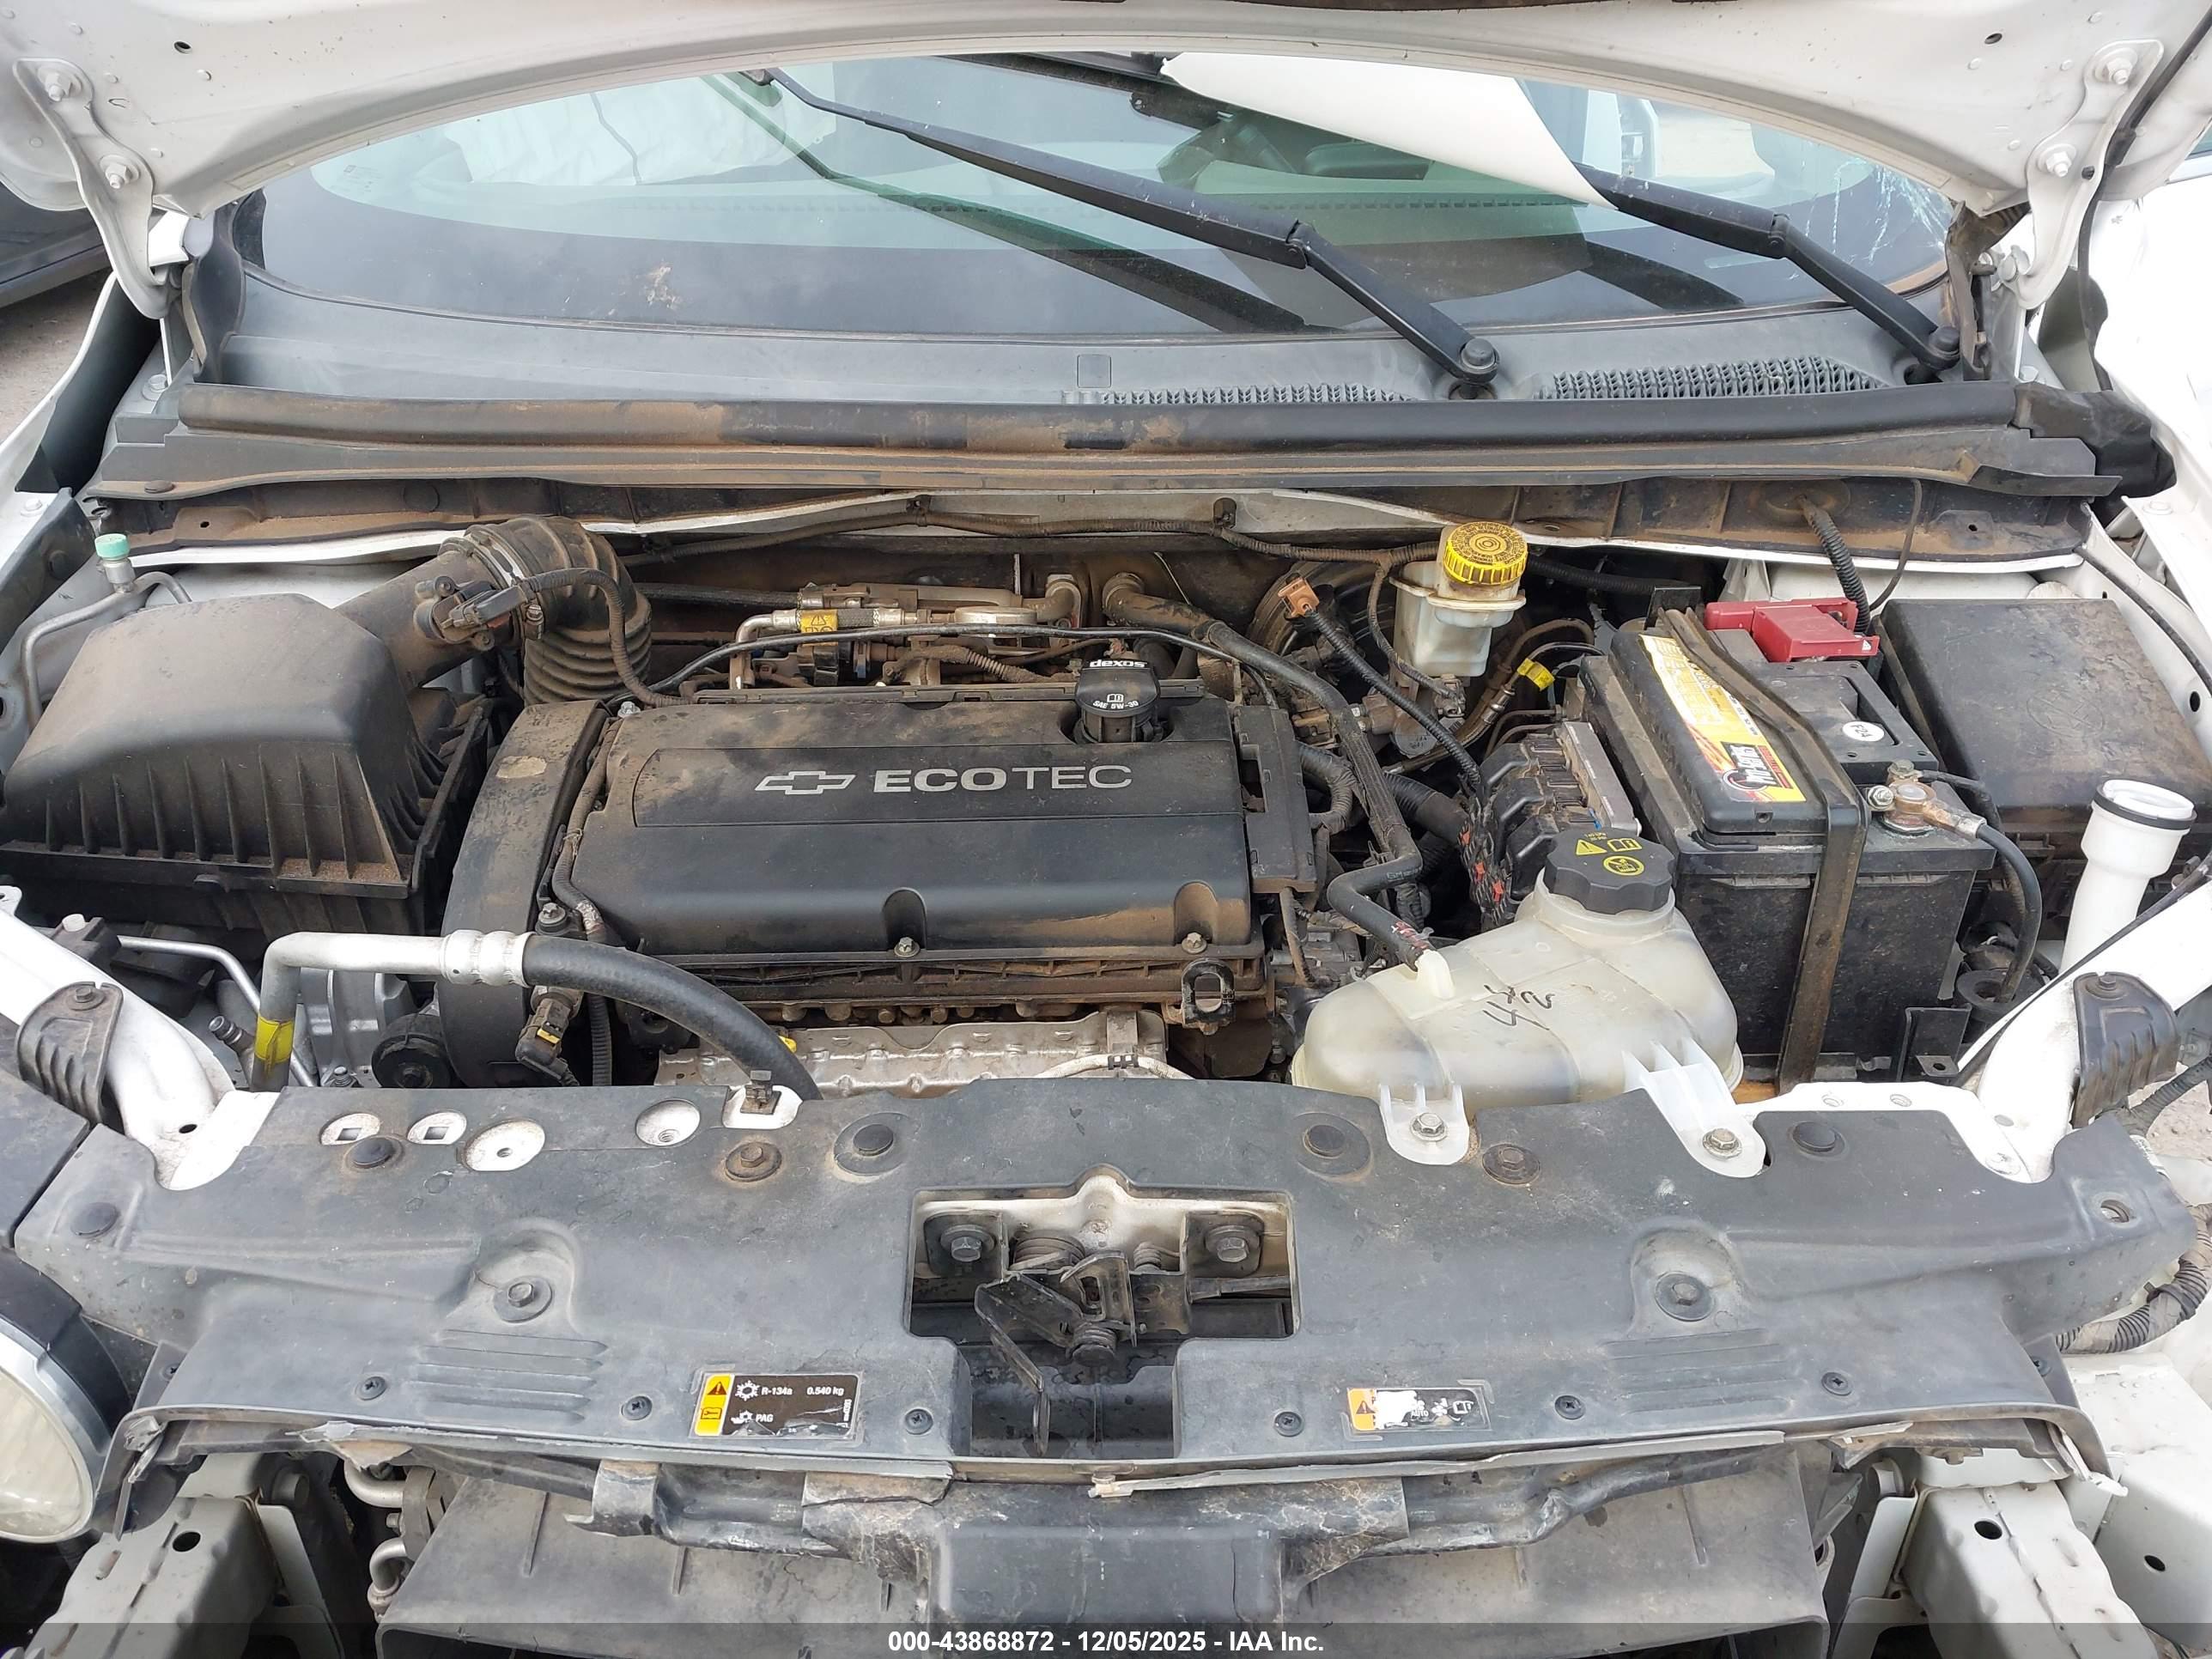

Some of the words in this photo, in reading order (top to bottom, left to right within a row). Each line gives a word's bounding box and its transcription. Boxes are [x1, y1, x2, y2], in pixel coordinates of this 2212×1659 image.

[1089, 659, 1148, 668] dexos
[1092, 700, 1109, 709] SAE
[873, 764, 1133, 793] ECOTEC
[761, 1386, 793, 1396] R-134a
[806, 1386, 831, 1395] 0.540
[832, 1386, 844, 1397] kg
[755, 1413, 774, 1423] PAG
